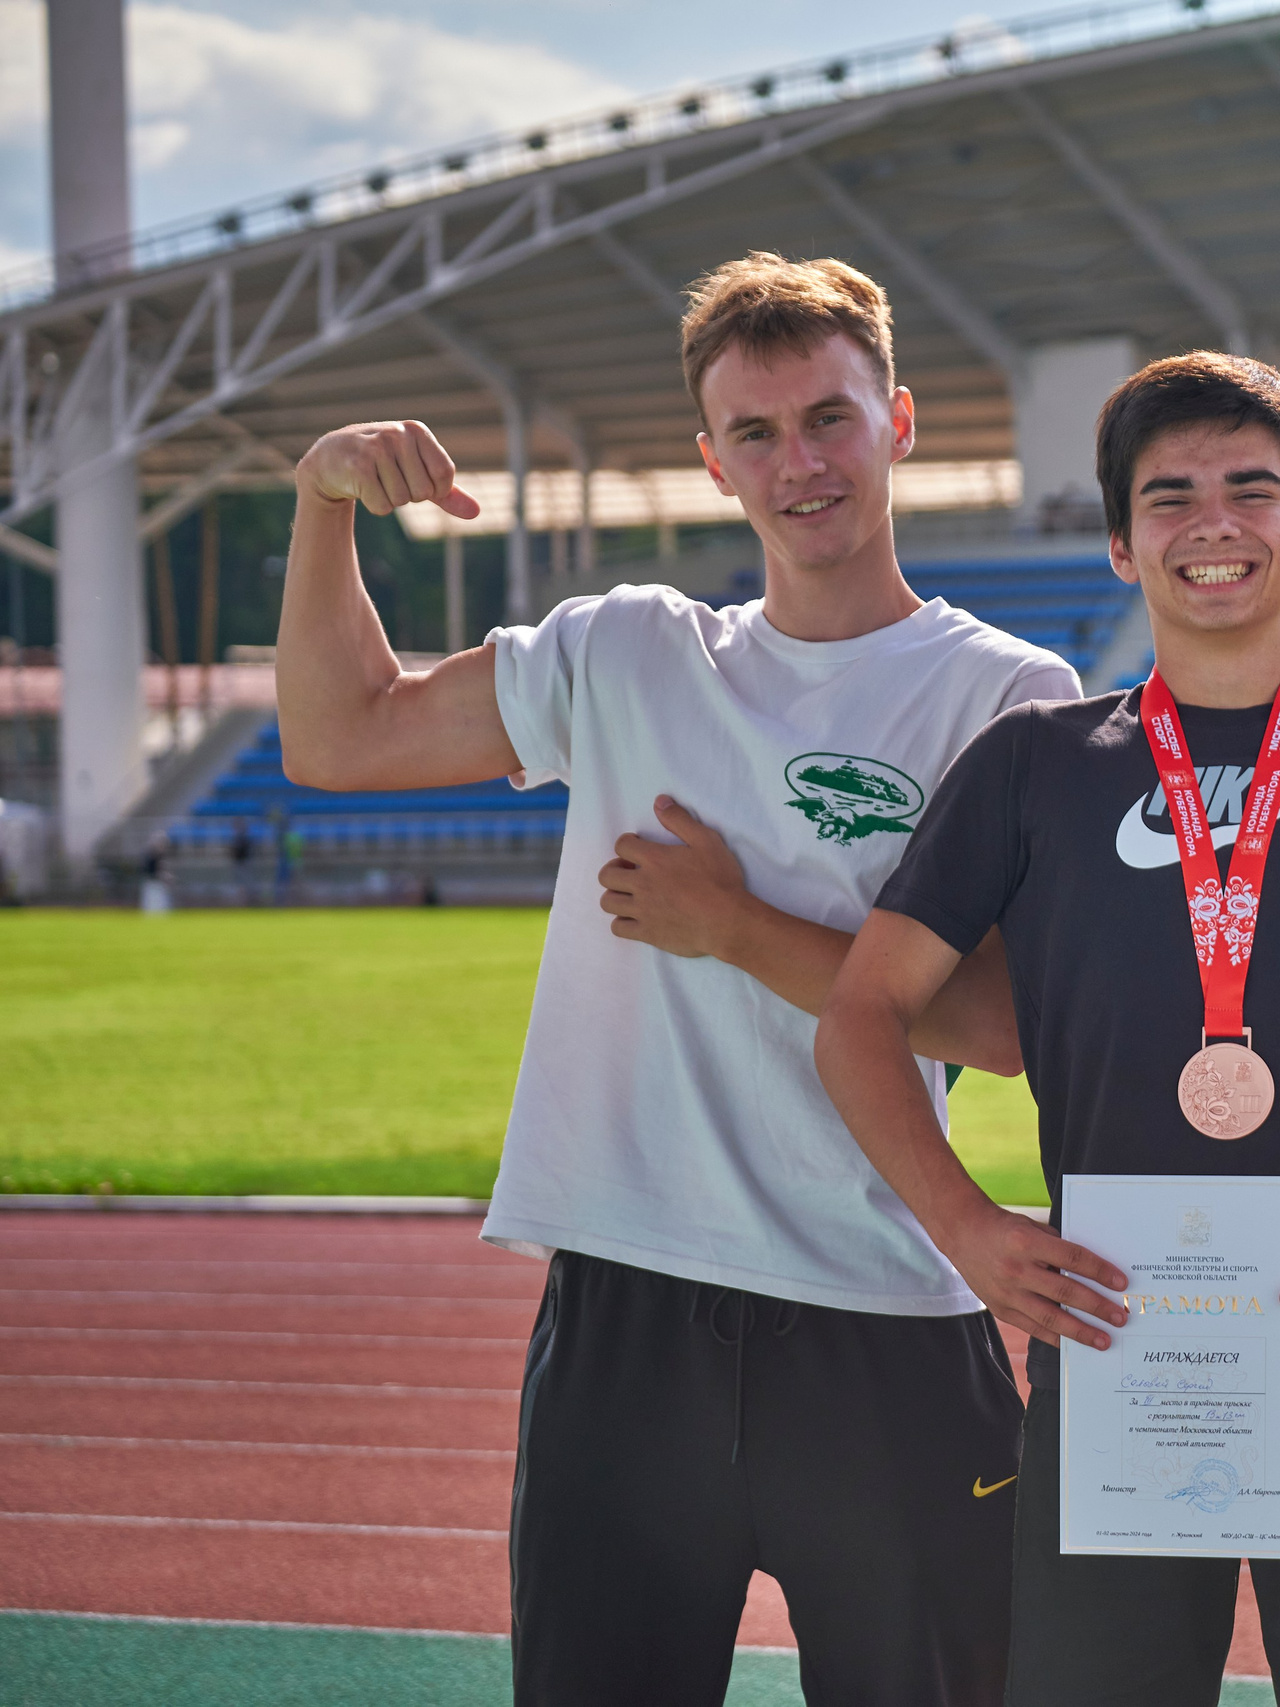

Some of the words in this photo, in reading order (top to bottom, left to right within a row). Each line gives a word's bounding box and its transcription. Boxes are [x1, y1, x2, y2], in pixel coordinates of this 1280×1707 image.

[1151, 716, 1169, 750] СПОРТ
[1184, 789, 1204, 839] КОМАНДА
[1245, 785, 1267, 833] КОМАНДА
[1173, 789, 1197, 857] ГУБЕРНАТОРА
[1165, 1255, 1225, 1263] МИНИСТЕРСТВО
[1131, 1264, 1181, 1272] ФИЗИЧЕСКОЙ
[1152, 1273, 1202, 1281] МОСКОВСКОЙ
[1122, 1294, 1265, 1316] ГРАМОТА
[1143, 1351, 1240, 1365] НАГРАЖДАЕТСЯ
[1129, 1397, 1138, 1406] За
[1189, 1398, 1222, 1409] тройном
[1223, 1400, 1252, 1409] прыжке
[1151, 1412, 1200, 1422] результатом
[1179, 1426, 1221, 1435] Московской
[1222, 1426, 1252, 1435] области
[1164, 1440, 1189, 1448] легкой
[1189, 1440, 1226, 1448] атлетике
[1101, 1484, 1137, 1495] Министр
